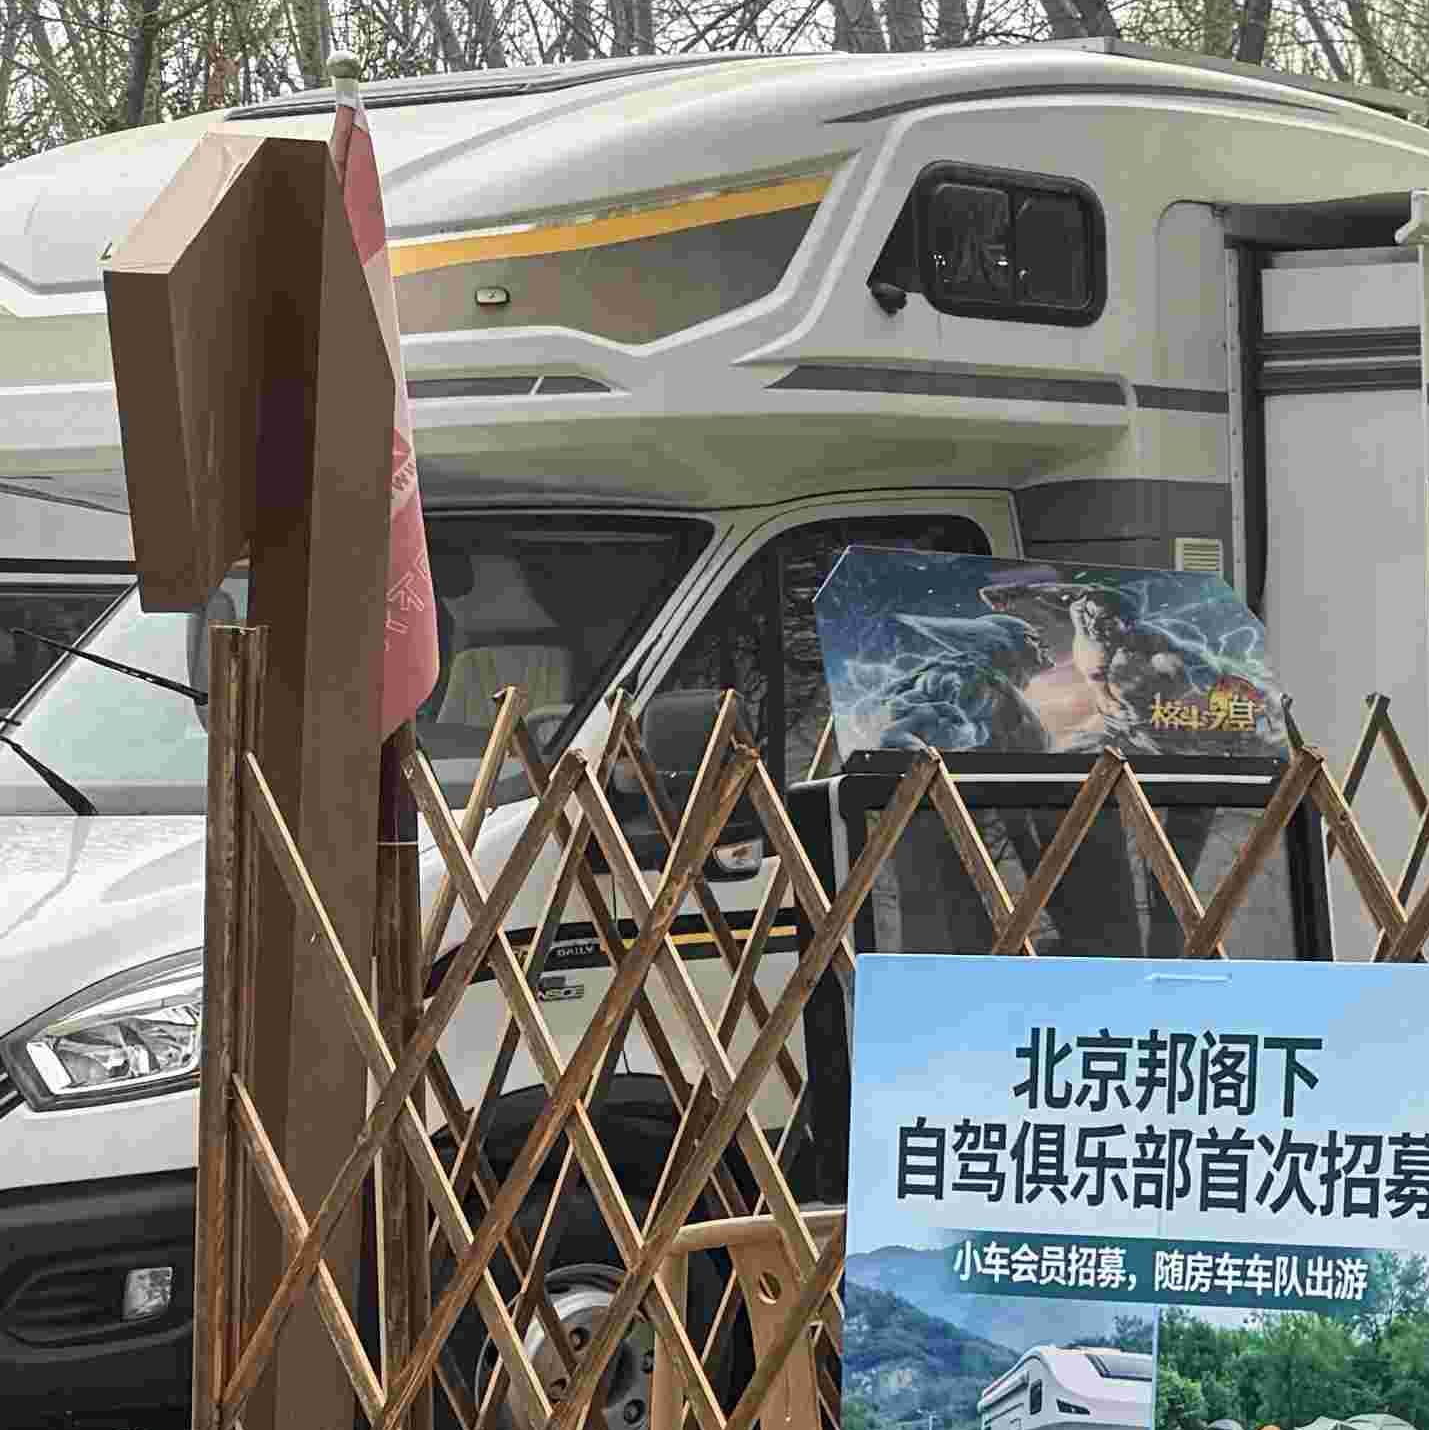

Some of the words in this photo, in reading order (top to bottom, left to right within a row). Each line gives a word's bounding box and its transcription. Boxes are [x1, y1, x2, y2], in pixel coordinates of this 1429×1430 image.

[1012, 1027, 1323, 1118] 北京邦阁下
